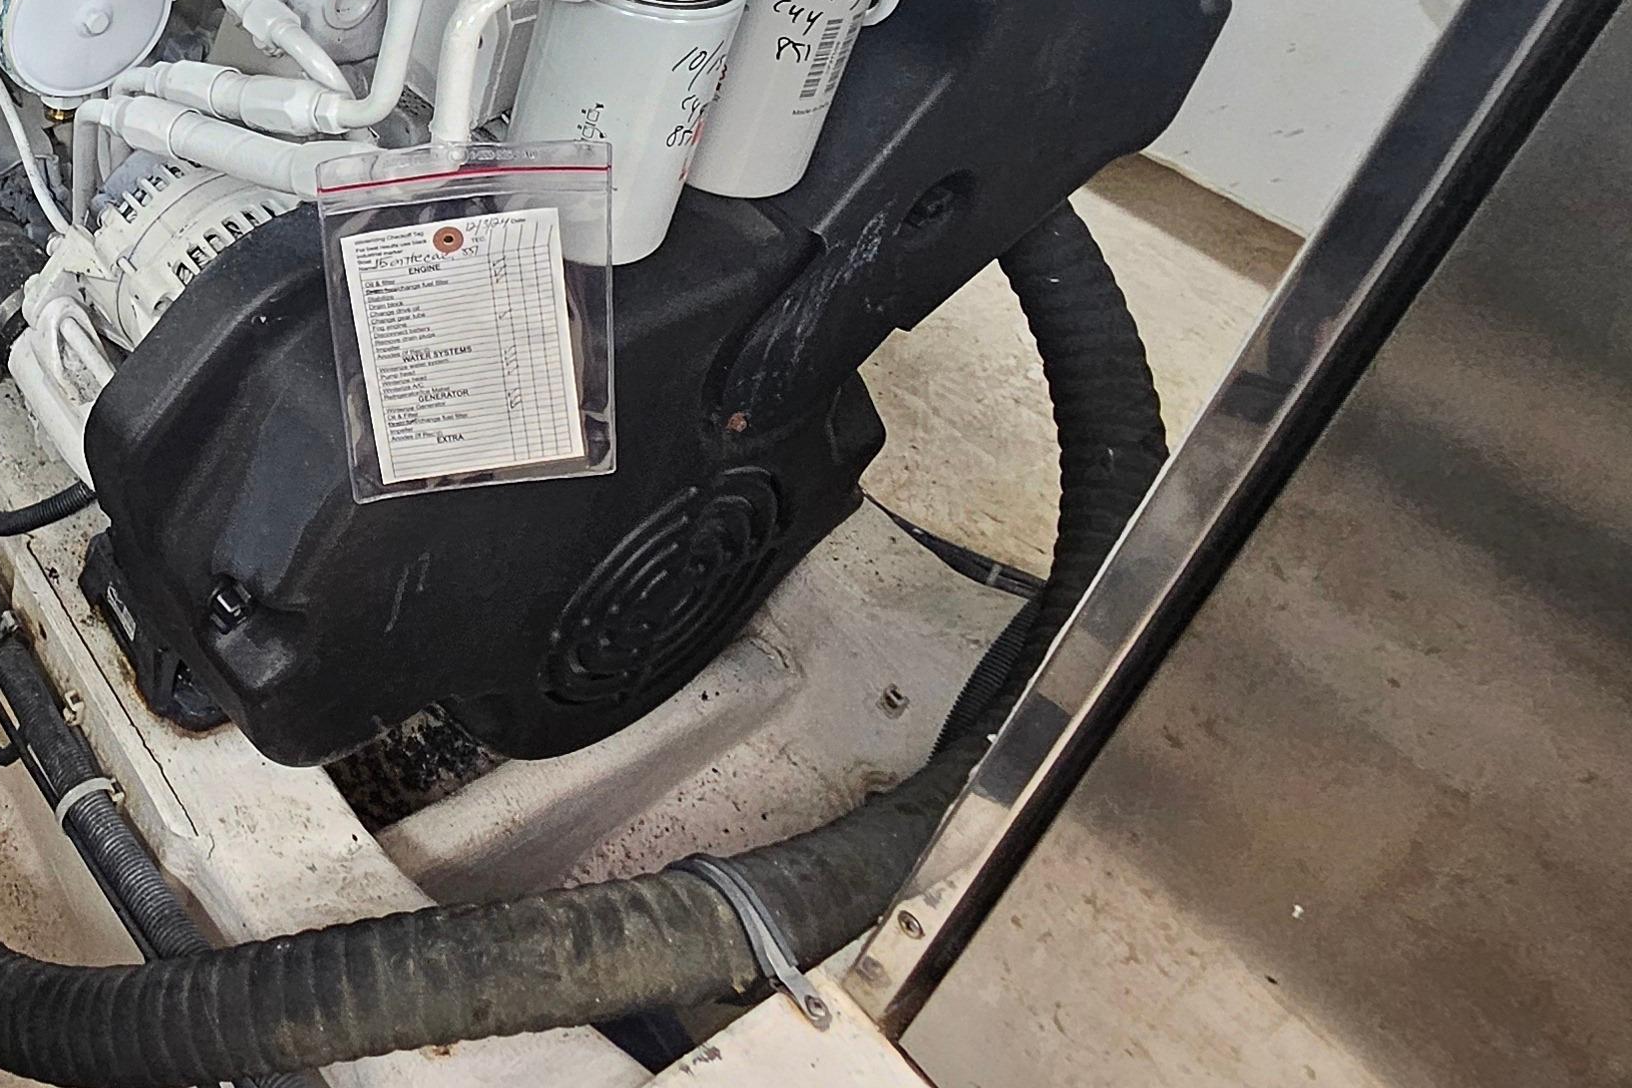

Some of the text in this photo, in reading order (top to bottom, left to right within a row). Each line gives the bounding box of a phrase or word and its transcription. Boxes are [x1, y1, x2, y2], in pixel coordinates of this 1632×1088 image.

[408, 265, 441, 274] ENGINE
[403, 346, 472, 362] WATER SYSTEMS
[419, 390, 469, 402] GENERATOR
[437, 434, 464, 443] EXTRA
